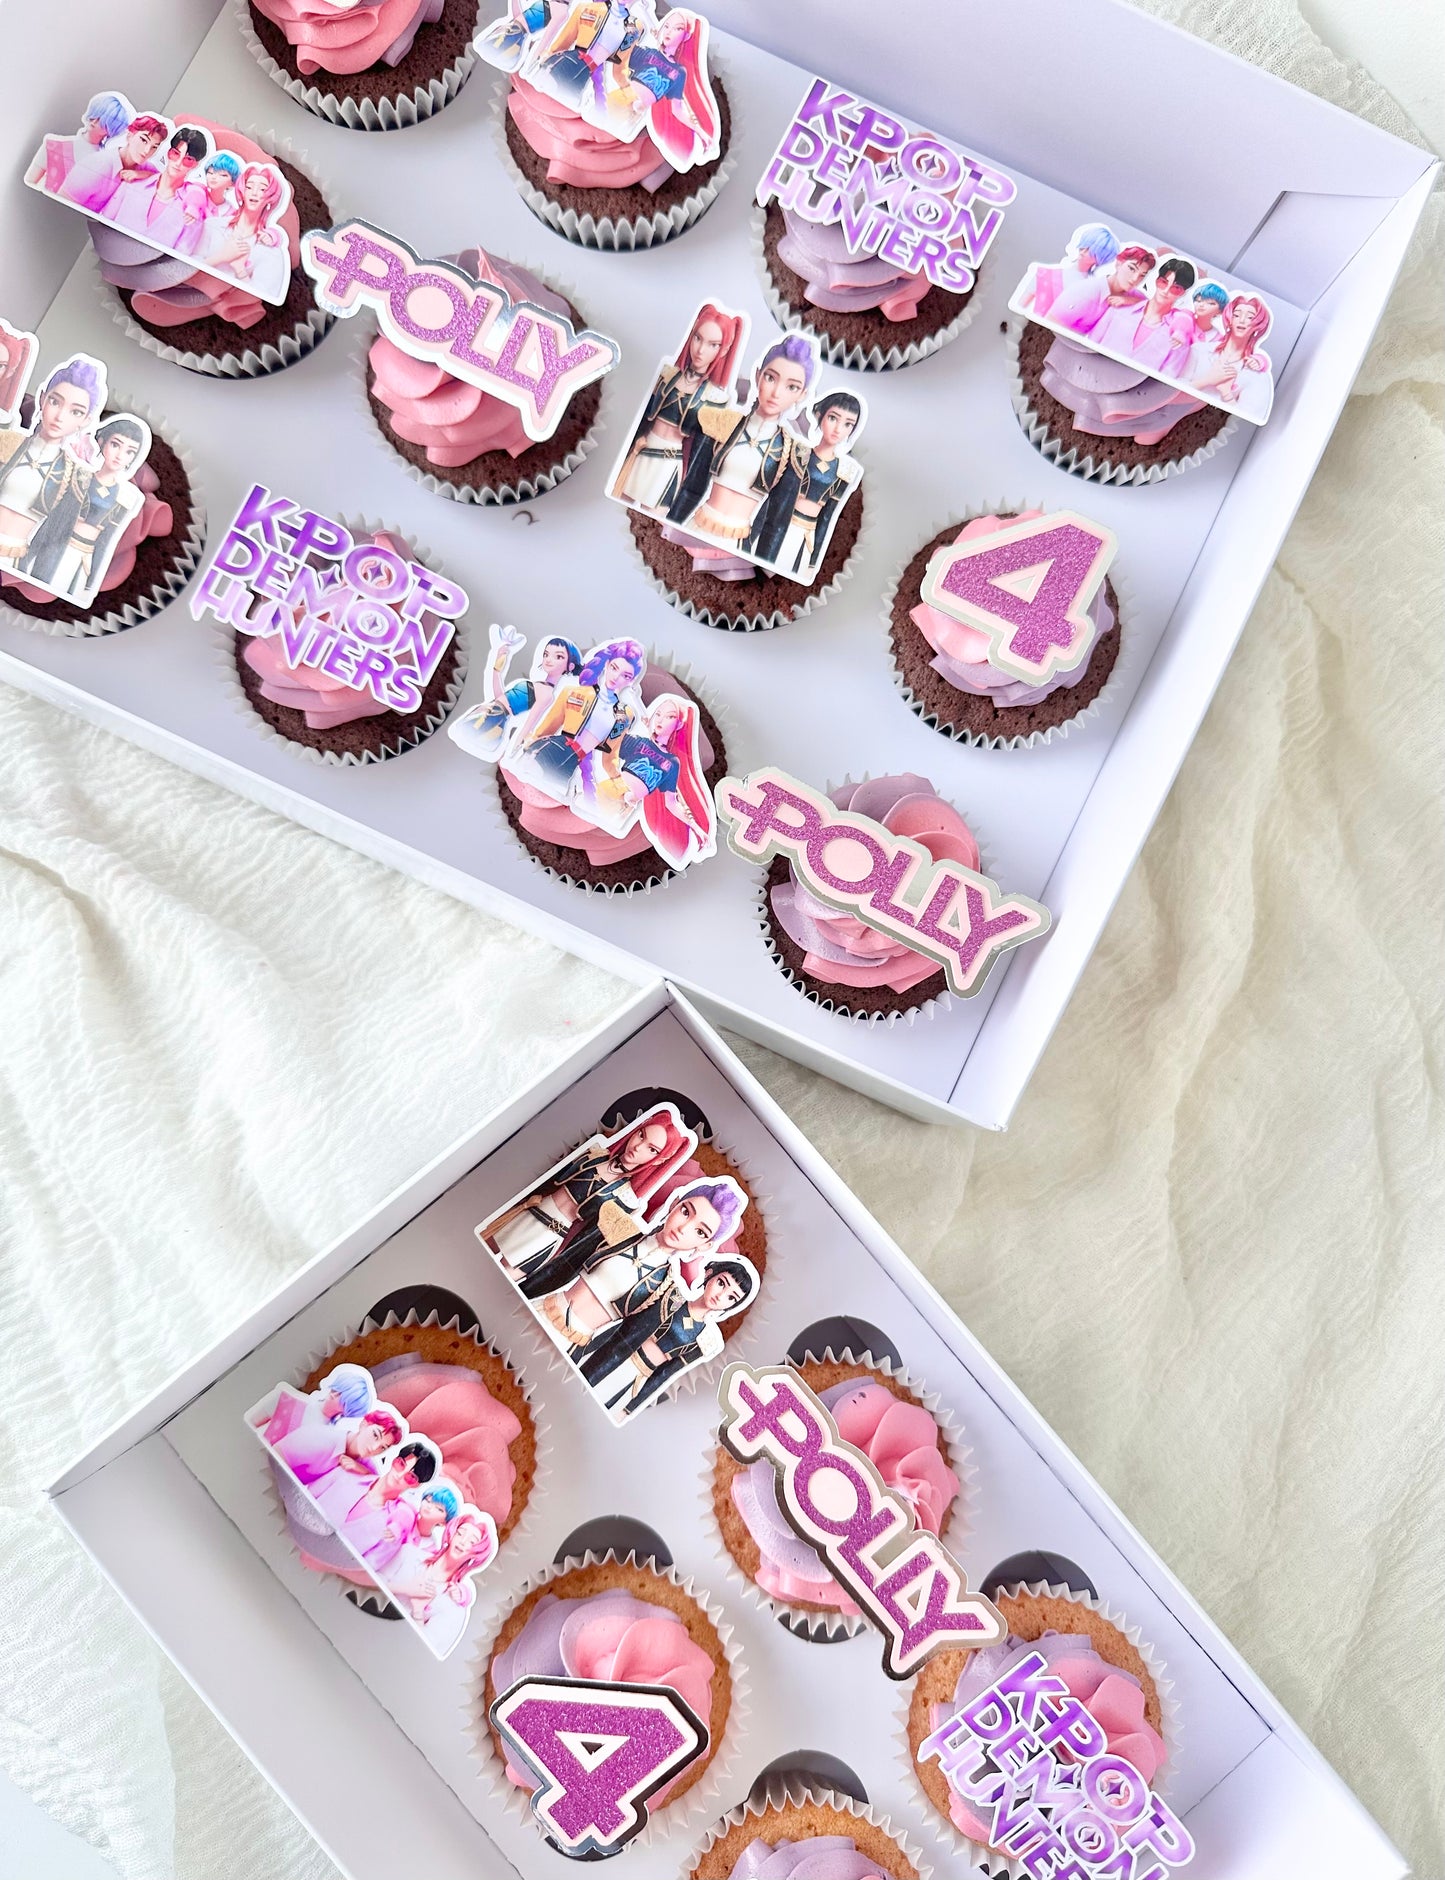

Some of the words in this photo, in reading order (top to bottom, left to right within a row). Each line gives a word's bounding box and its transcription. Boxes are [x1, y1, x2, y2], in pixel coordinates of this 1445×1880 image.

[778, 121, 1002, 264] DEMON
[797, 78, 1015, 205] K-POP
[757, 158, 972, 290] HUNTERS
[213, 532, 452, 682] DEMON
[233, 484, 468, 619] K-POP
[941, 523, 1103, 666] 4
[192, 569, 419, 709] HUNTERS
[505, 1698, 688, 1840] 4
[997, 1654, 1194, 1863] K-POP
